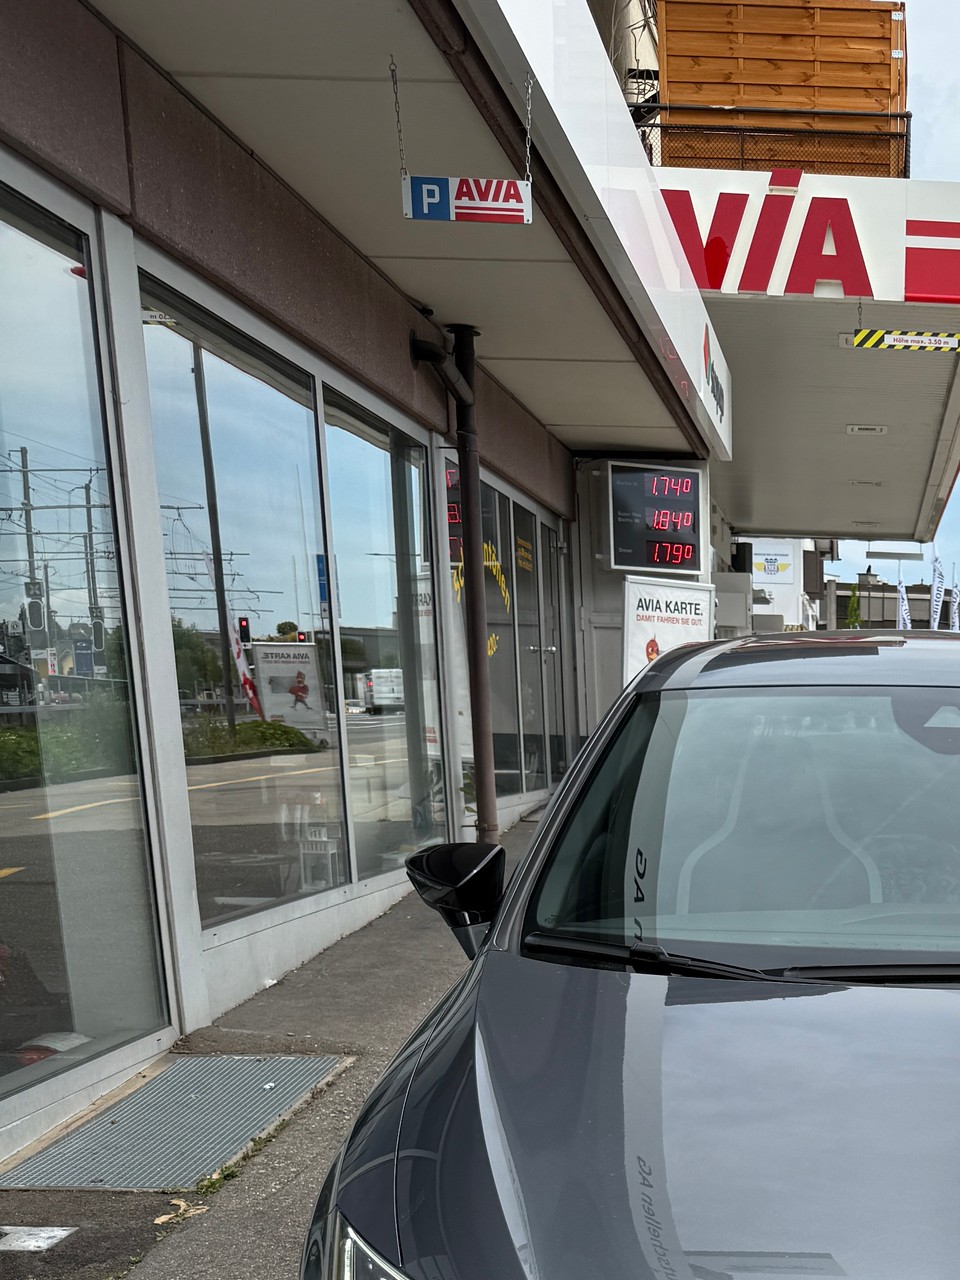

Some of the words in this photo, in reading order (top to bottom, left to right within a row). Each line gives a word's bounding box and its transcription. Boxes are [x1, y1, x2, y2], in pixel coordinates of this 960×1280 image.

[422, 184, 440, 214] P
[454, 178, 524, 204] AVIA
[659, 168, 874, 297] VIA
[927, 338, 942, 346] 3.50
[636, 597, 662, 613] AVIA
[665, 600, 703, 616] KARTE.
[636, 614, 656, 623] DAMIT
[656, 615, 680, 625] FAHREN
[680, 617, 690, 626] SIE
[690, 618, 703, 627] GUT.
